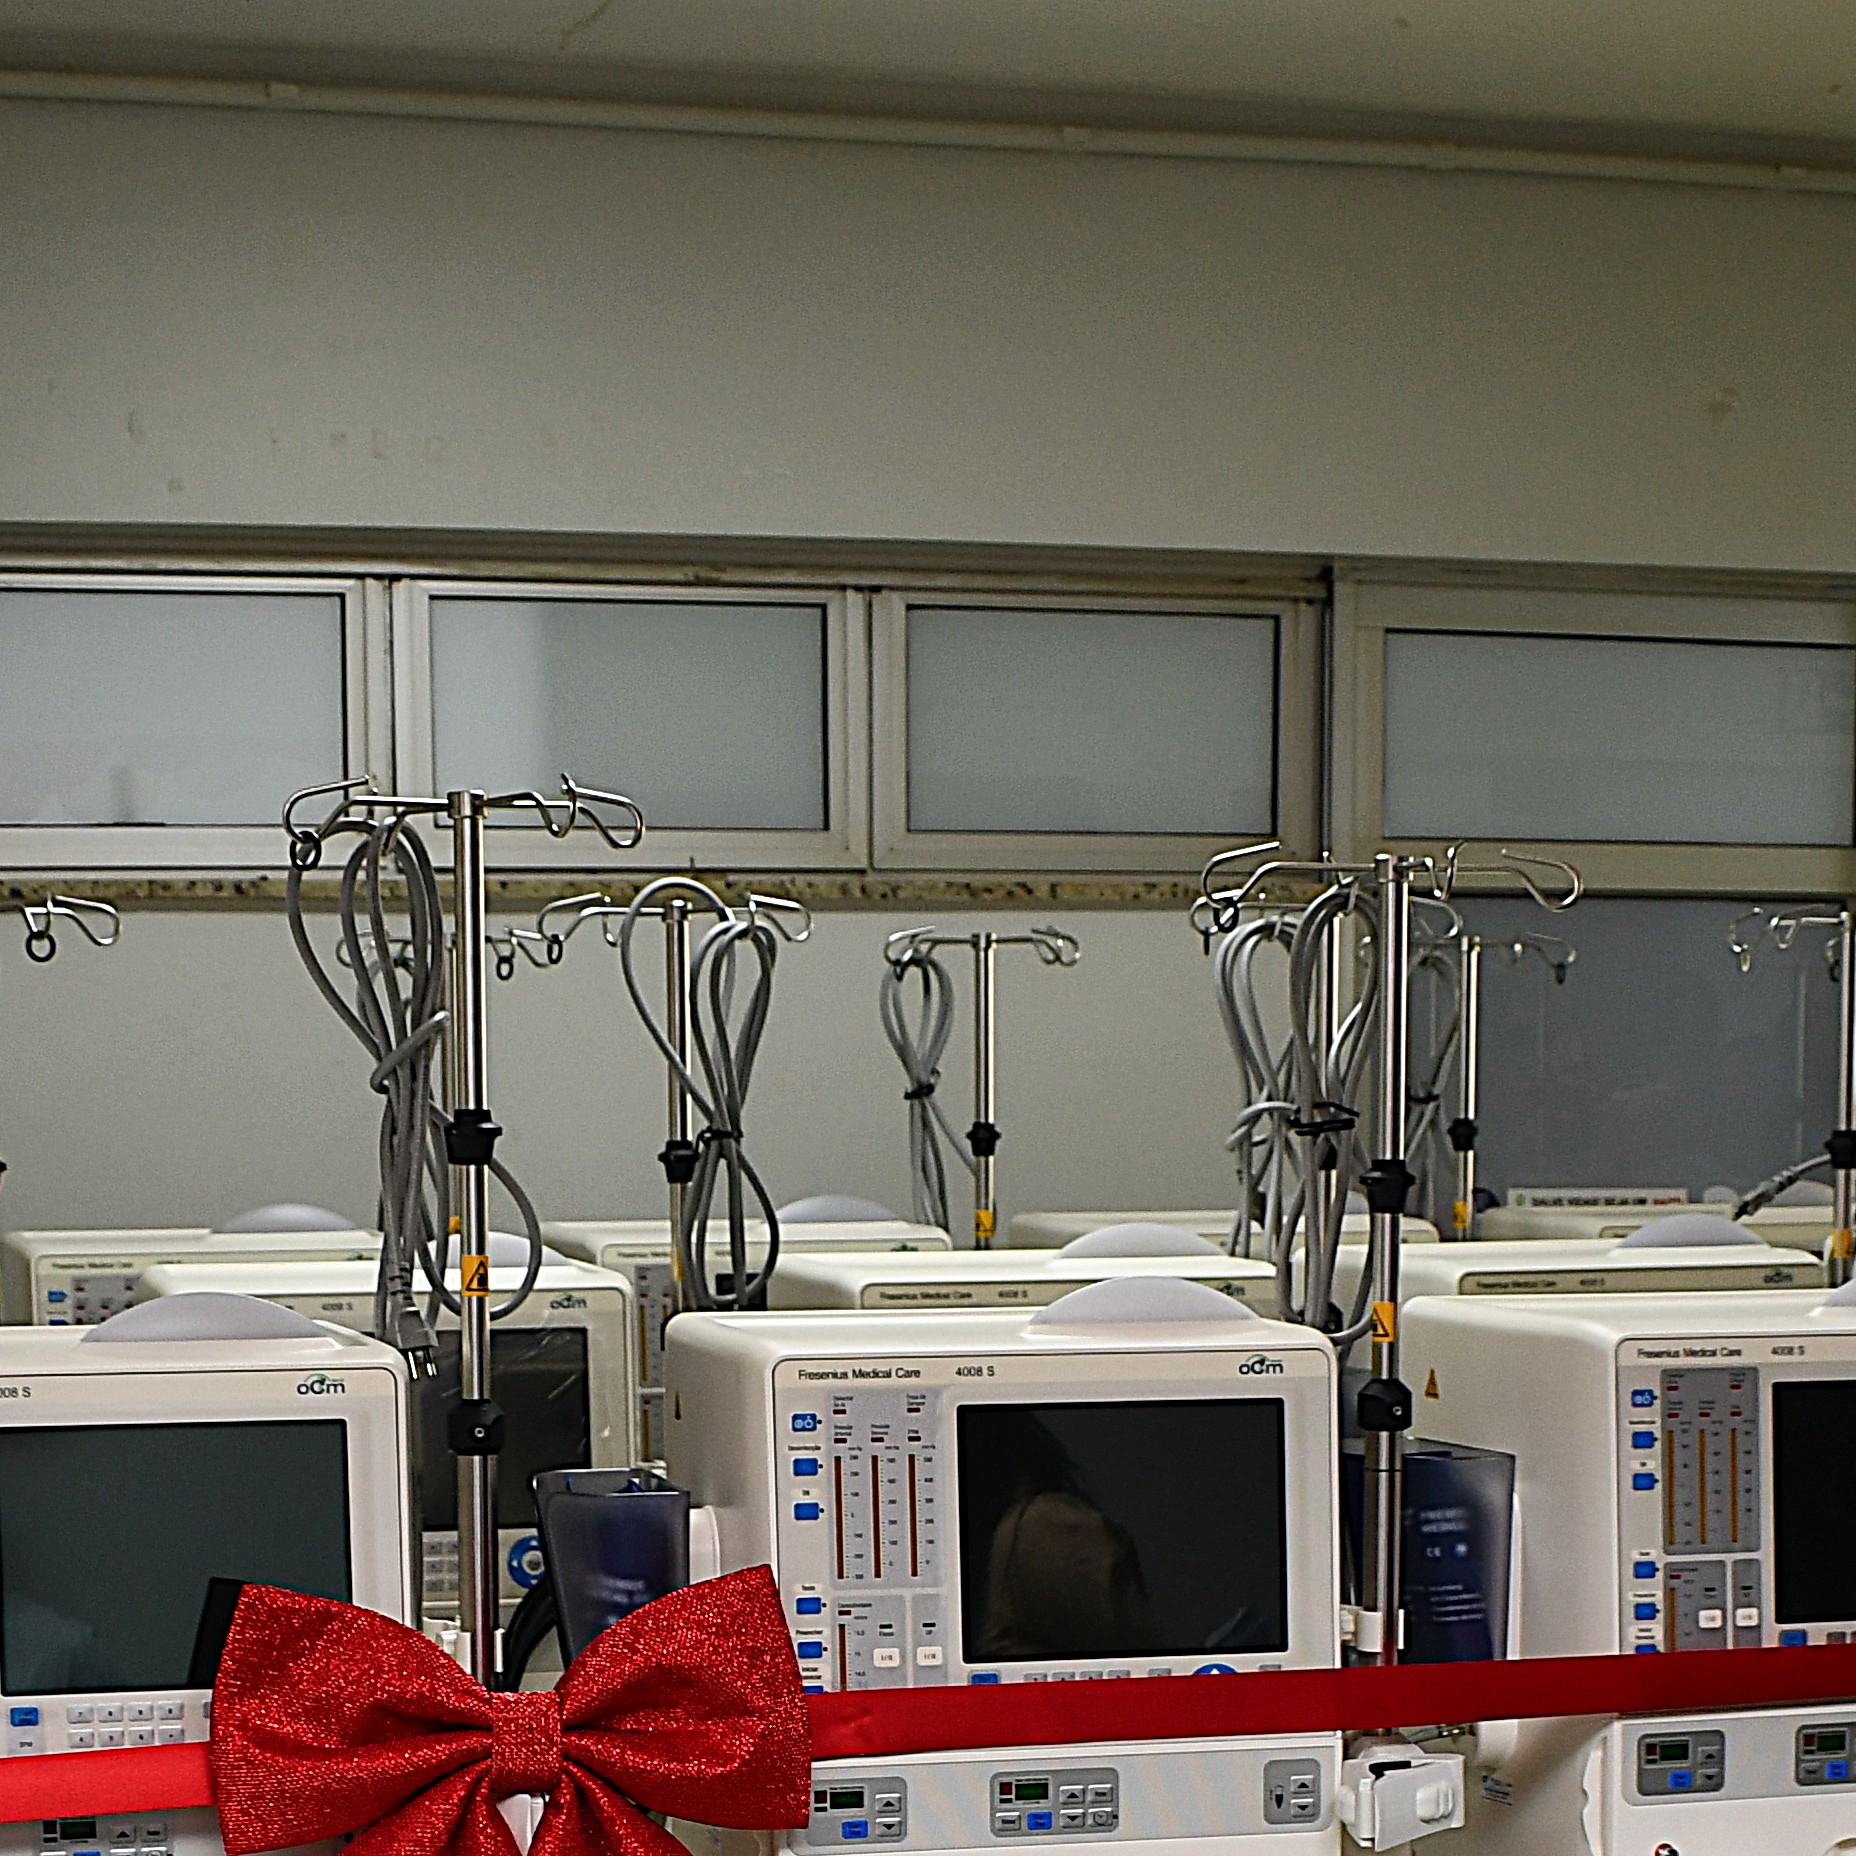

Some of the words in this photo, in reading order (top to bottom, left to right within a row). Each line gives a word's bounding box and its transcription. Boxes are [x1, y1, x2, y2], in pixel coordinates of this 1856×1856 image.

[1720, 1347, 1742, 1357] Care
[955, 1366, 983, 1377] 4008
[987, 1366, 995, 1377] S
[1239, 1360, 1284, 1374] oCm
[798, 1370, 848, 1380] Fresenius
[852, 1368, 892, 1378] Medical
[895, 1368, 921, 1378] Care
[22, 1387, 31, 1398] S
[297, 1380, 345, 1395] oCm
